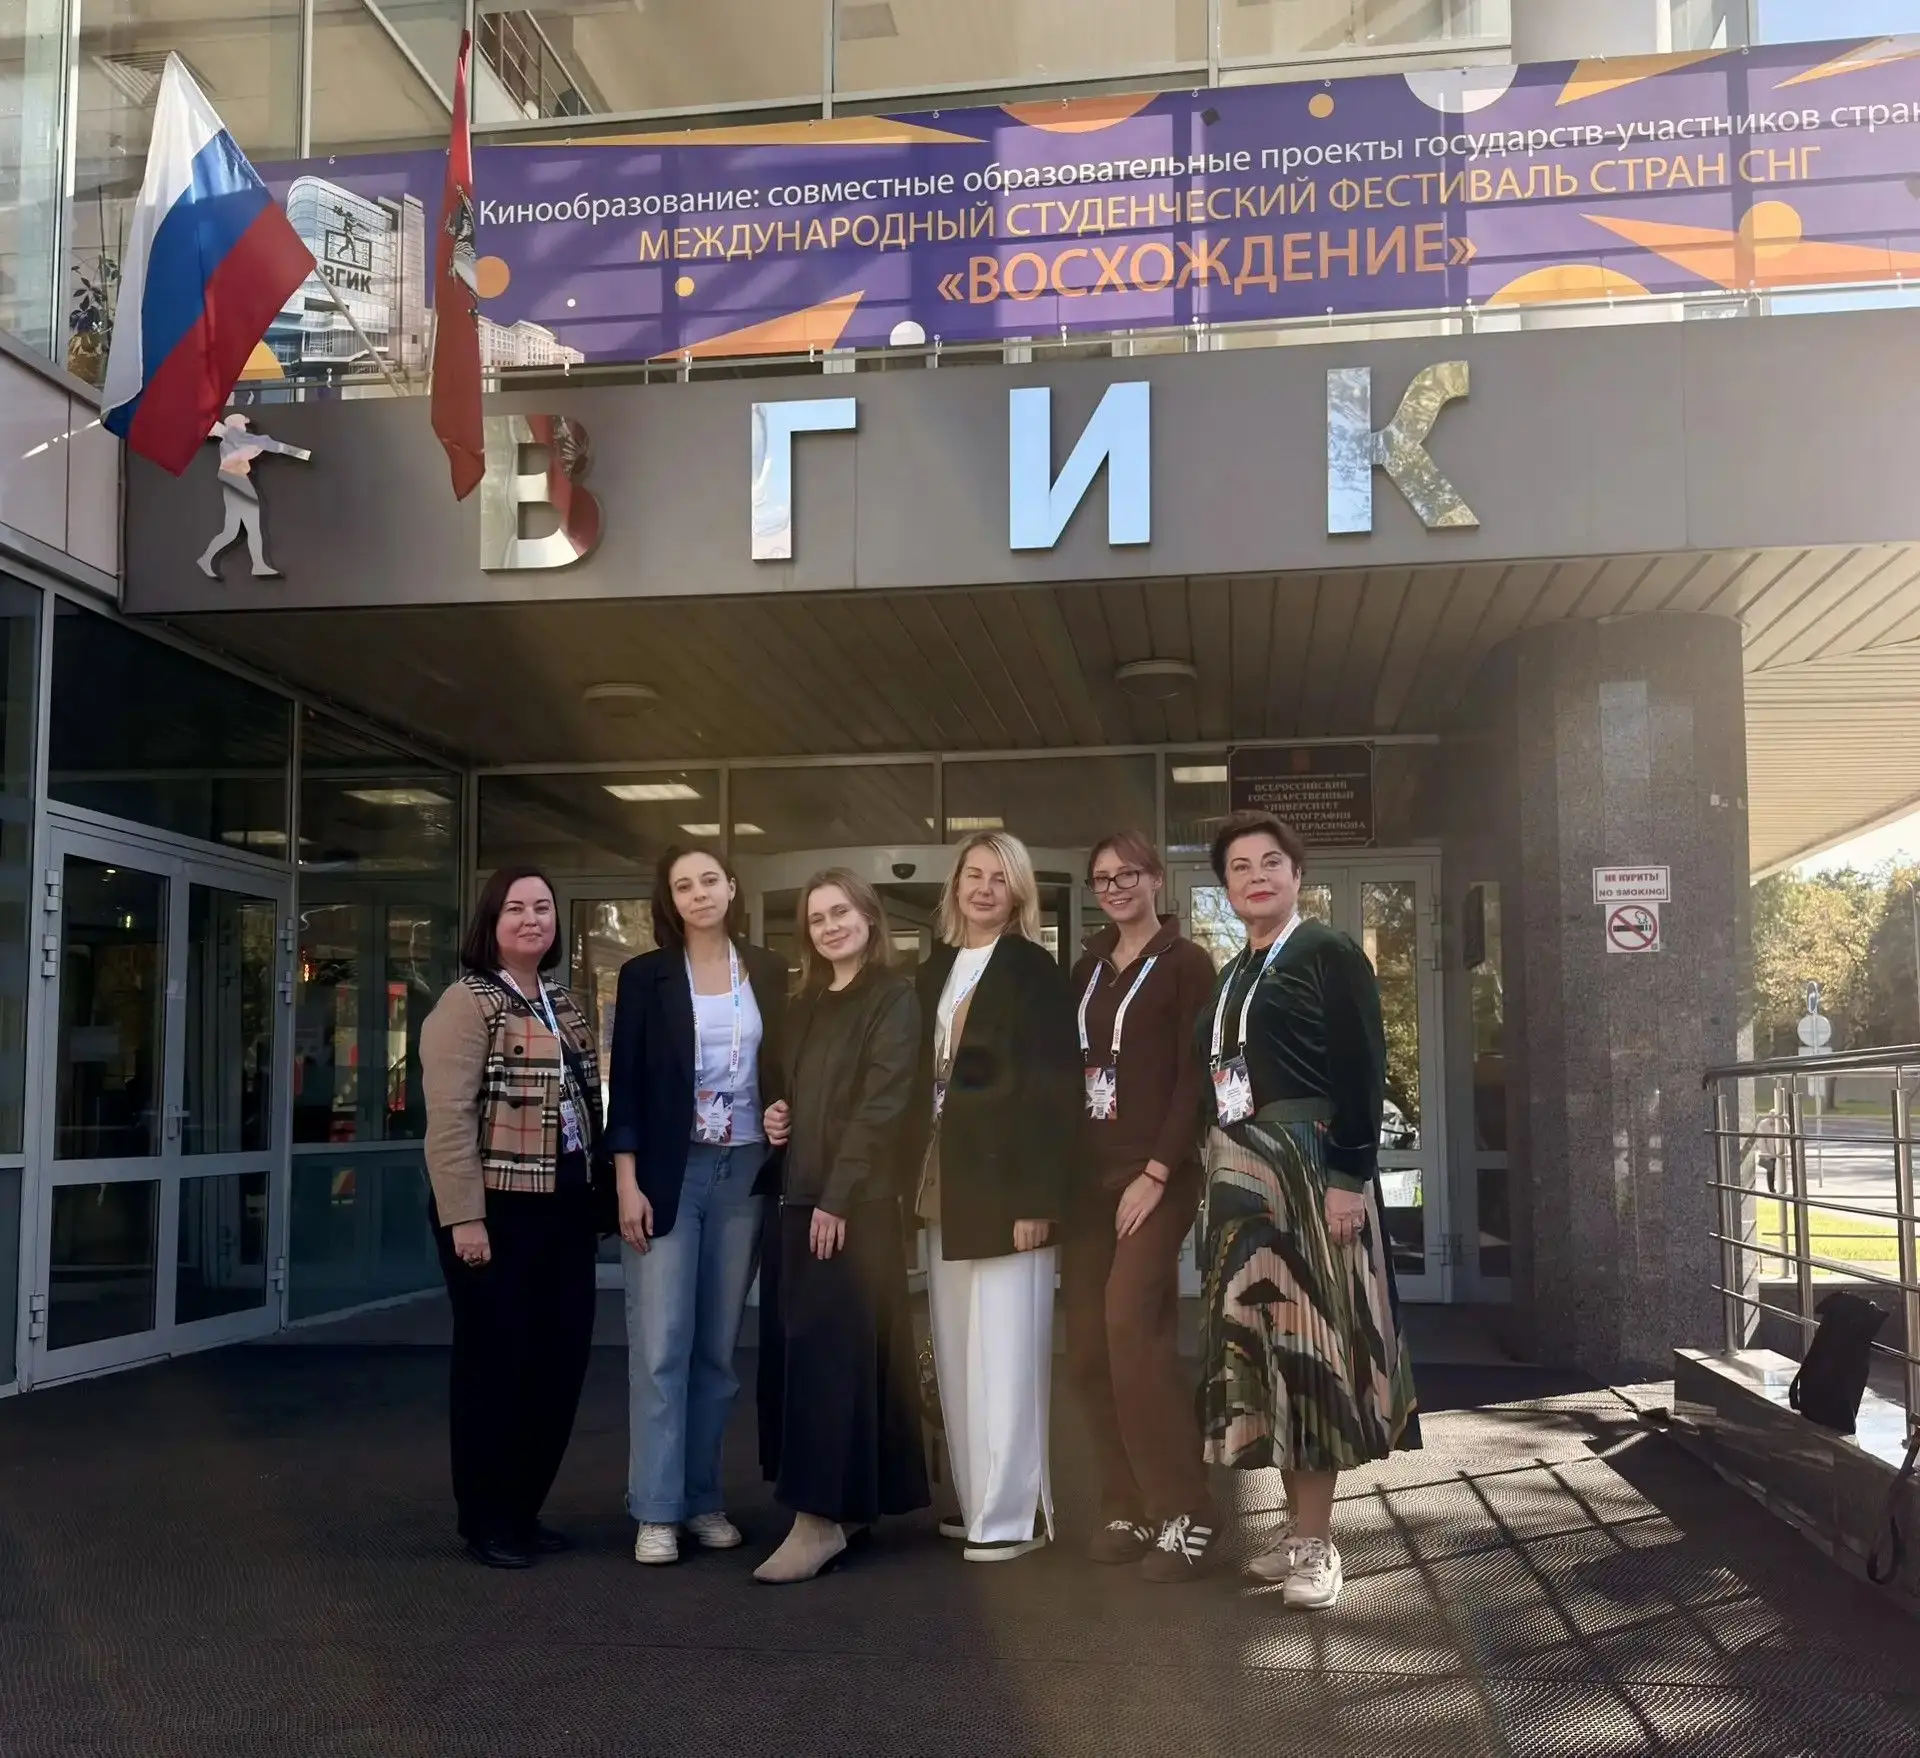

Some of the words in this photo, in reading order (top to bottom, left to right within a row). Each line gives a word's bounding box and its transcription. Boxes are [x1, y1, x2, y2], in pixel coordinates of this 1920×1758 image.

[479, 187, 761, 226] Кинообразование:
[767, 173, 954, 207] совместные
[963, 146, 1251, 196] образовательные
[1261, 138, 1404, 174] проекты
[1414, 107, 1821, 162] государств-участников
[638, 203, 995, 263] МЕЖДУНАРОДНЫЙ
[1006, 176, 1316, 238] СТУДЕНЧЕСКИЙ
[1329, 164, 1578, 213] ФЕСТИВАЛЬ
[1590, 153, 1726, 196] СТРАН
[1739, 145, 1821, 183] СНГ
[324, 265, 372, 294] ВГИК
[937, 223, 1479, 305] «ВОСХОЖДЕНИЕ»
[480, 360, 1480, 574] ВГИК
[1599, 889, 1613, 897] NO
[1616, 888, 1665, 896] SMOKING!
[1605, 874, 1616, 882] НЕ
